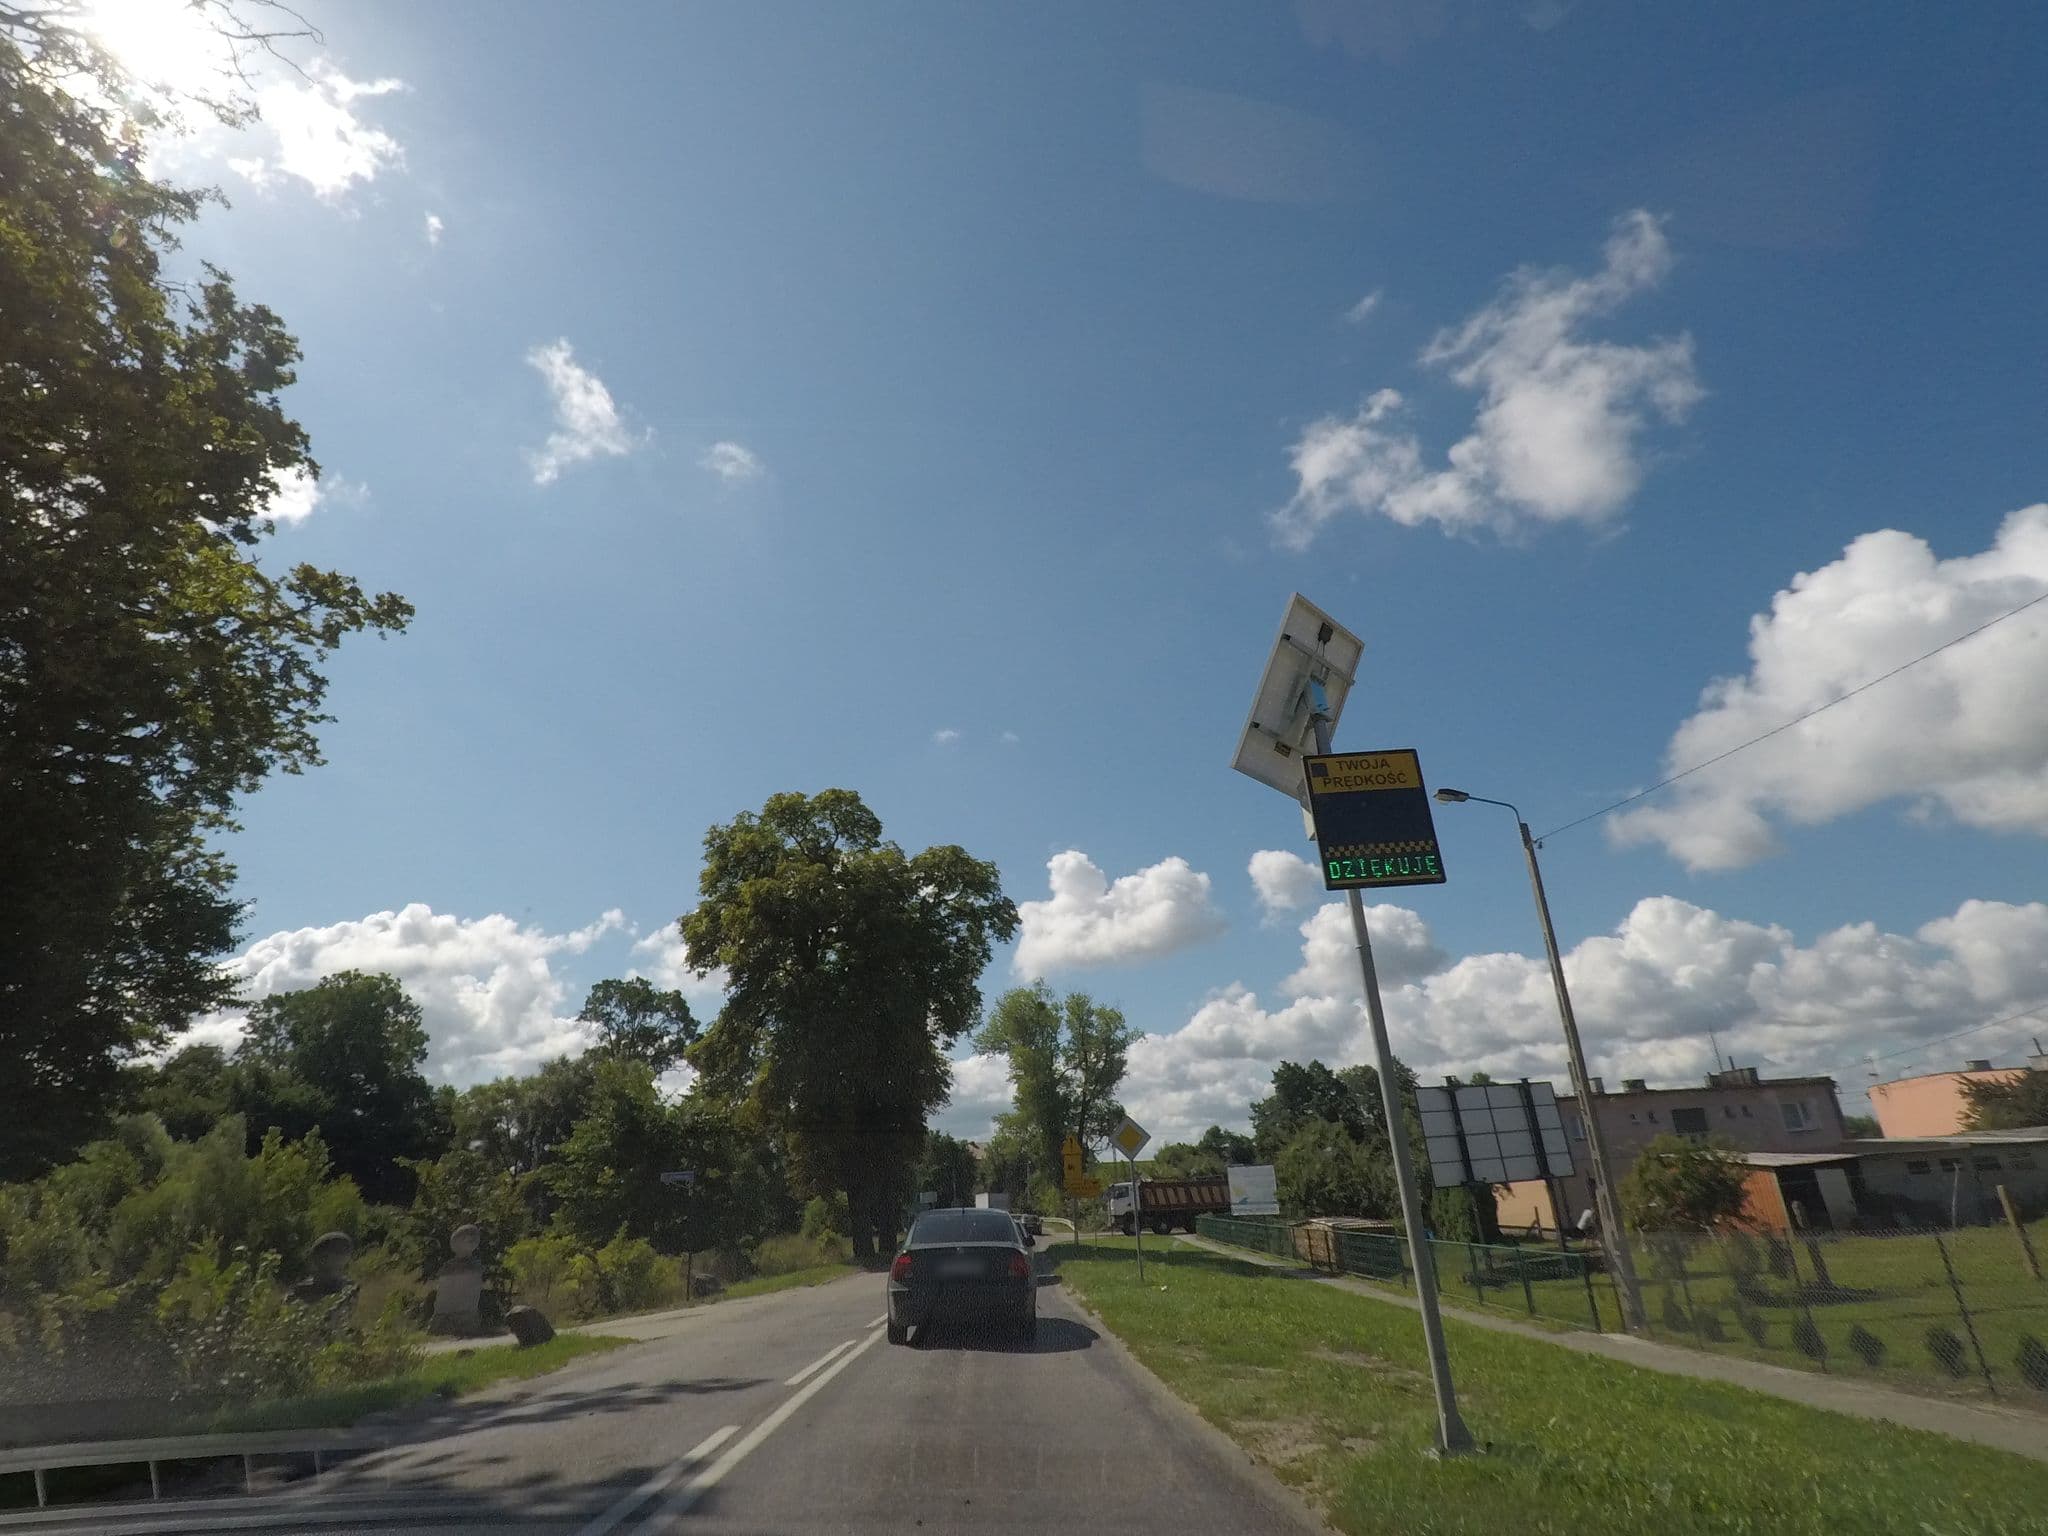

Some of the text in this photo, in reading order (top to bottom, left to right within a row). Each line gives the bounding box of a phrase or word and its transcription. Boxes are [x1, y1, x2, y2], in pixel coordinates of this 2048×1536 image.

[1335, 758, 1391, 771] TWOJA
[1322, 771, 1408, 788] PRĘDKOŚĆ
[1328, 855, 1439, 880] DZIĘKUJĘ
